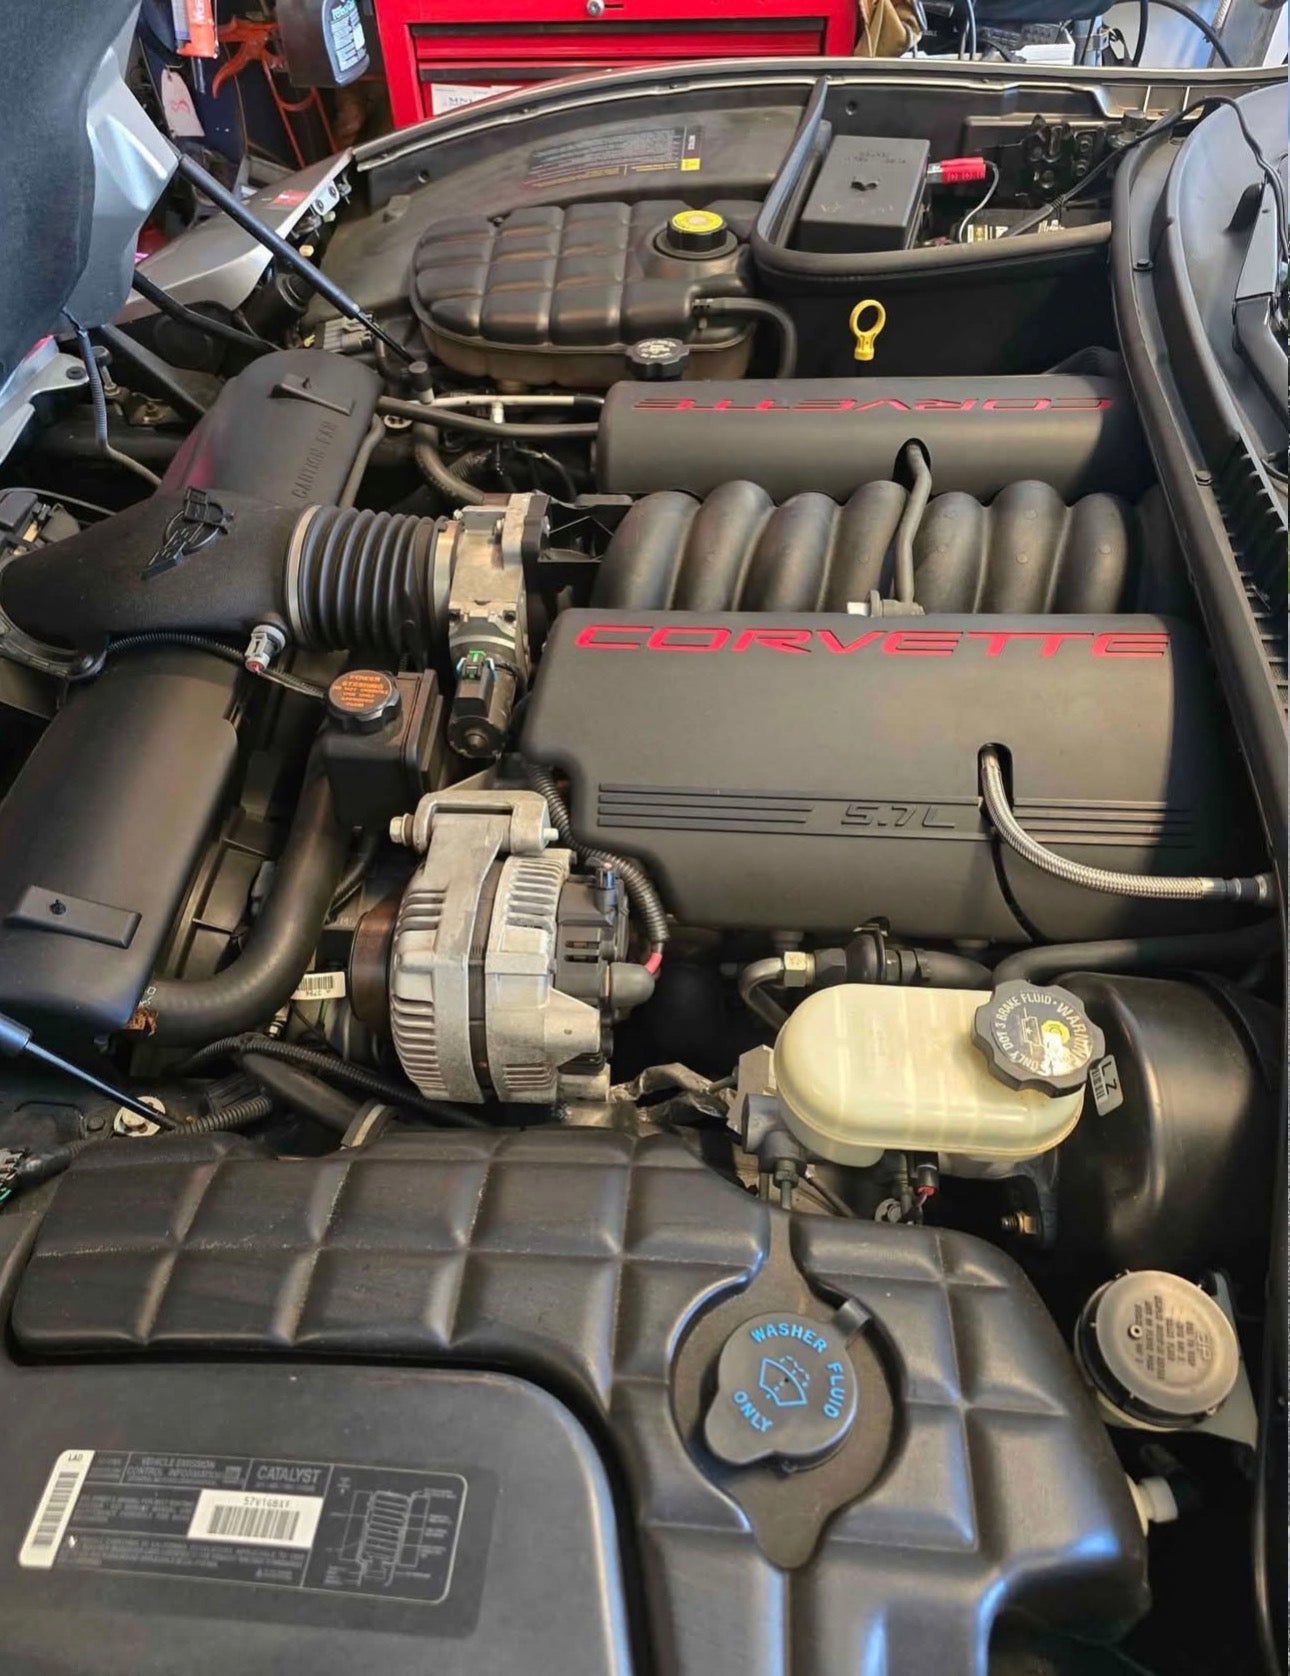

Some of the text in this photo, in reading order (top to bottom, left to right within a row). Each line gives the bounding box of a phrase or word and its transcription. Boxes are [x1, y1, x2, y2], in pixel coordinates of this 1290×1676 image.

[632, 398, 1114, 411] CORVETTE
[292, 447, 325, 498] CAUTION
[575, 624, 1171, 657] CORVETTE
[841, 803, 956, 829] 5.7L
[996, 996, 1021, 1020] BRAKE
[1020, 993, 1052, 1004] FLUID
[996, 1032, 1014, 1051] DOT
[1009, 1050, 1039, 1073] ONLY
[733, 1322, 846, 1432] WASHER FLUID ONLY
[256, 1465, 322, 1484] CATALYST
